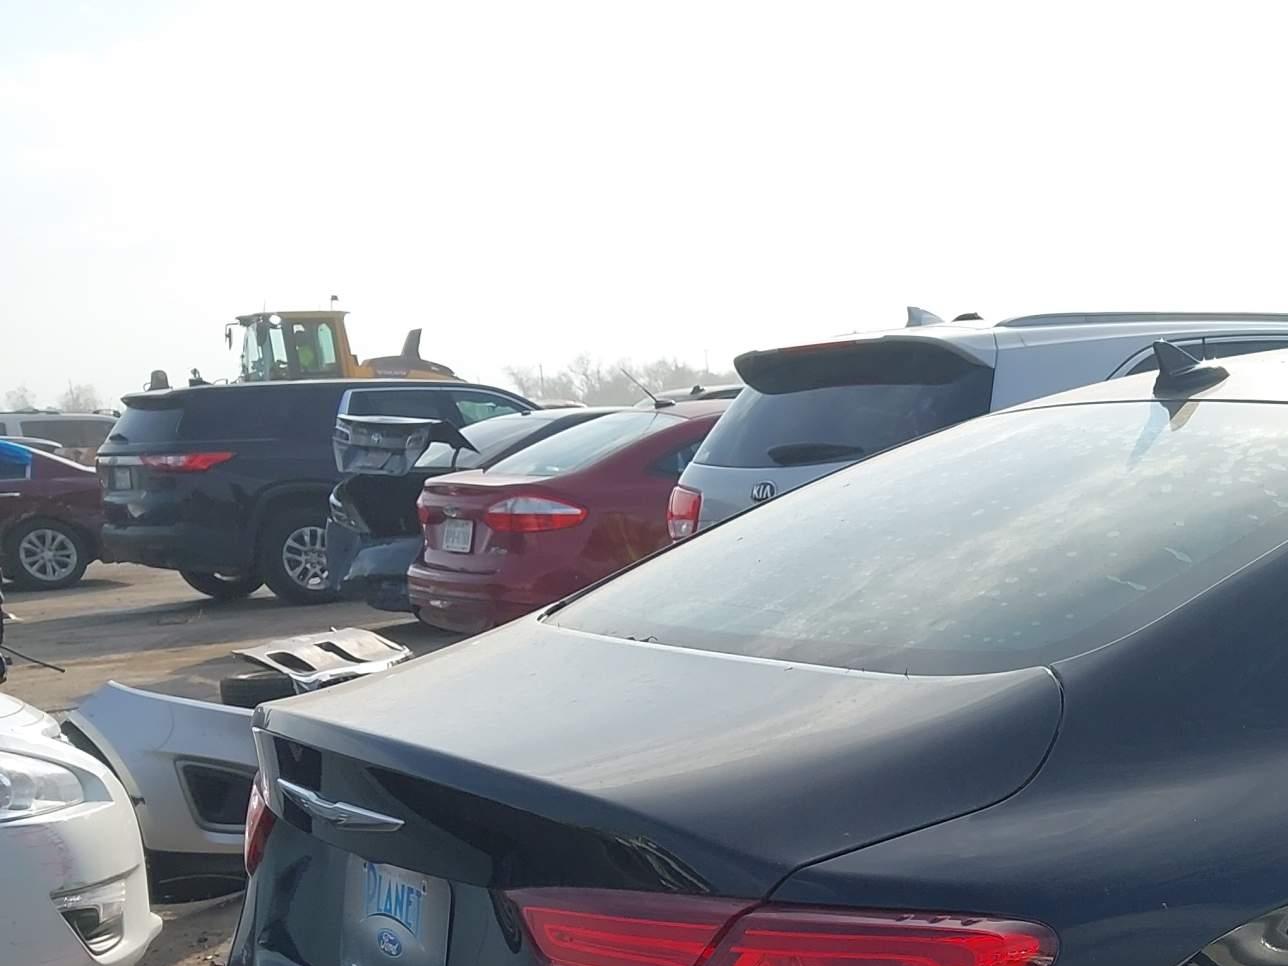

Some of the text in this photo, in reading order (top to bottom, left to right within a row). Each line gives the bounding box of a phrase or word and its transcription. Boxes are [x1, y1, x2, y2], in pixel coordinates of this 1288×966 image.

[752, 484, 771, 499] KIA
[365, 862, 422, 939] PLANET
[379, 932, 400, 956] Ford
